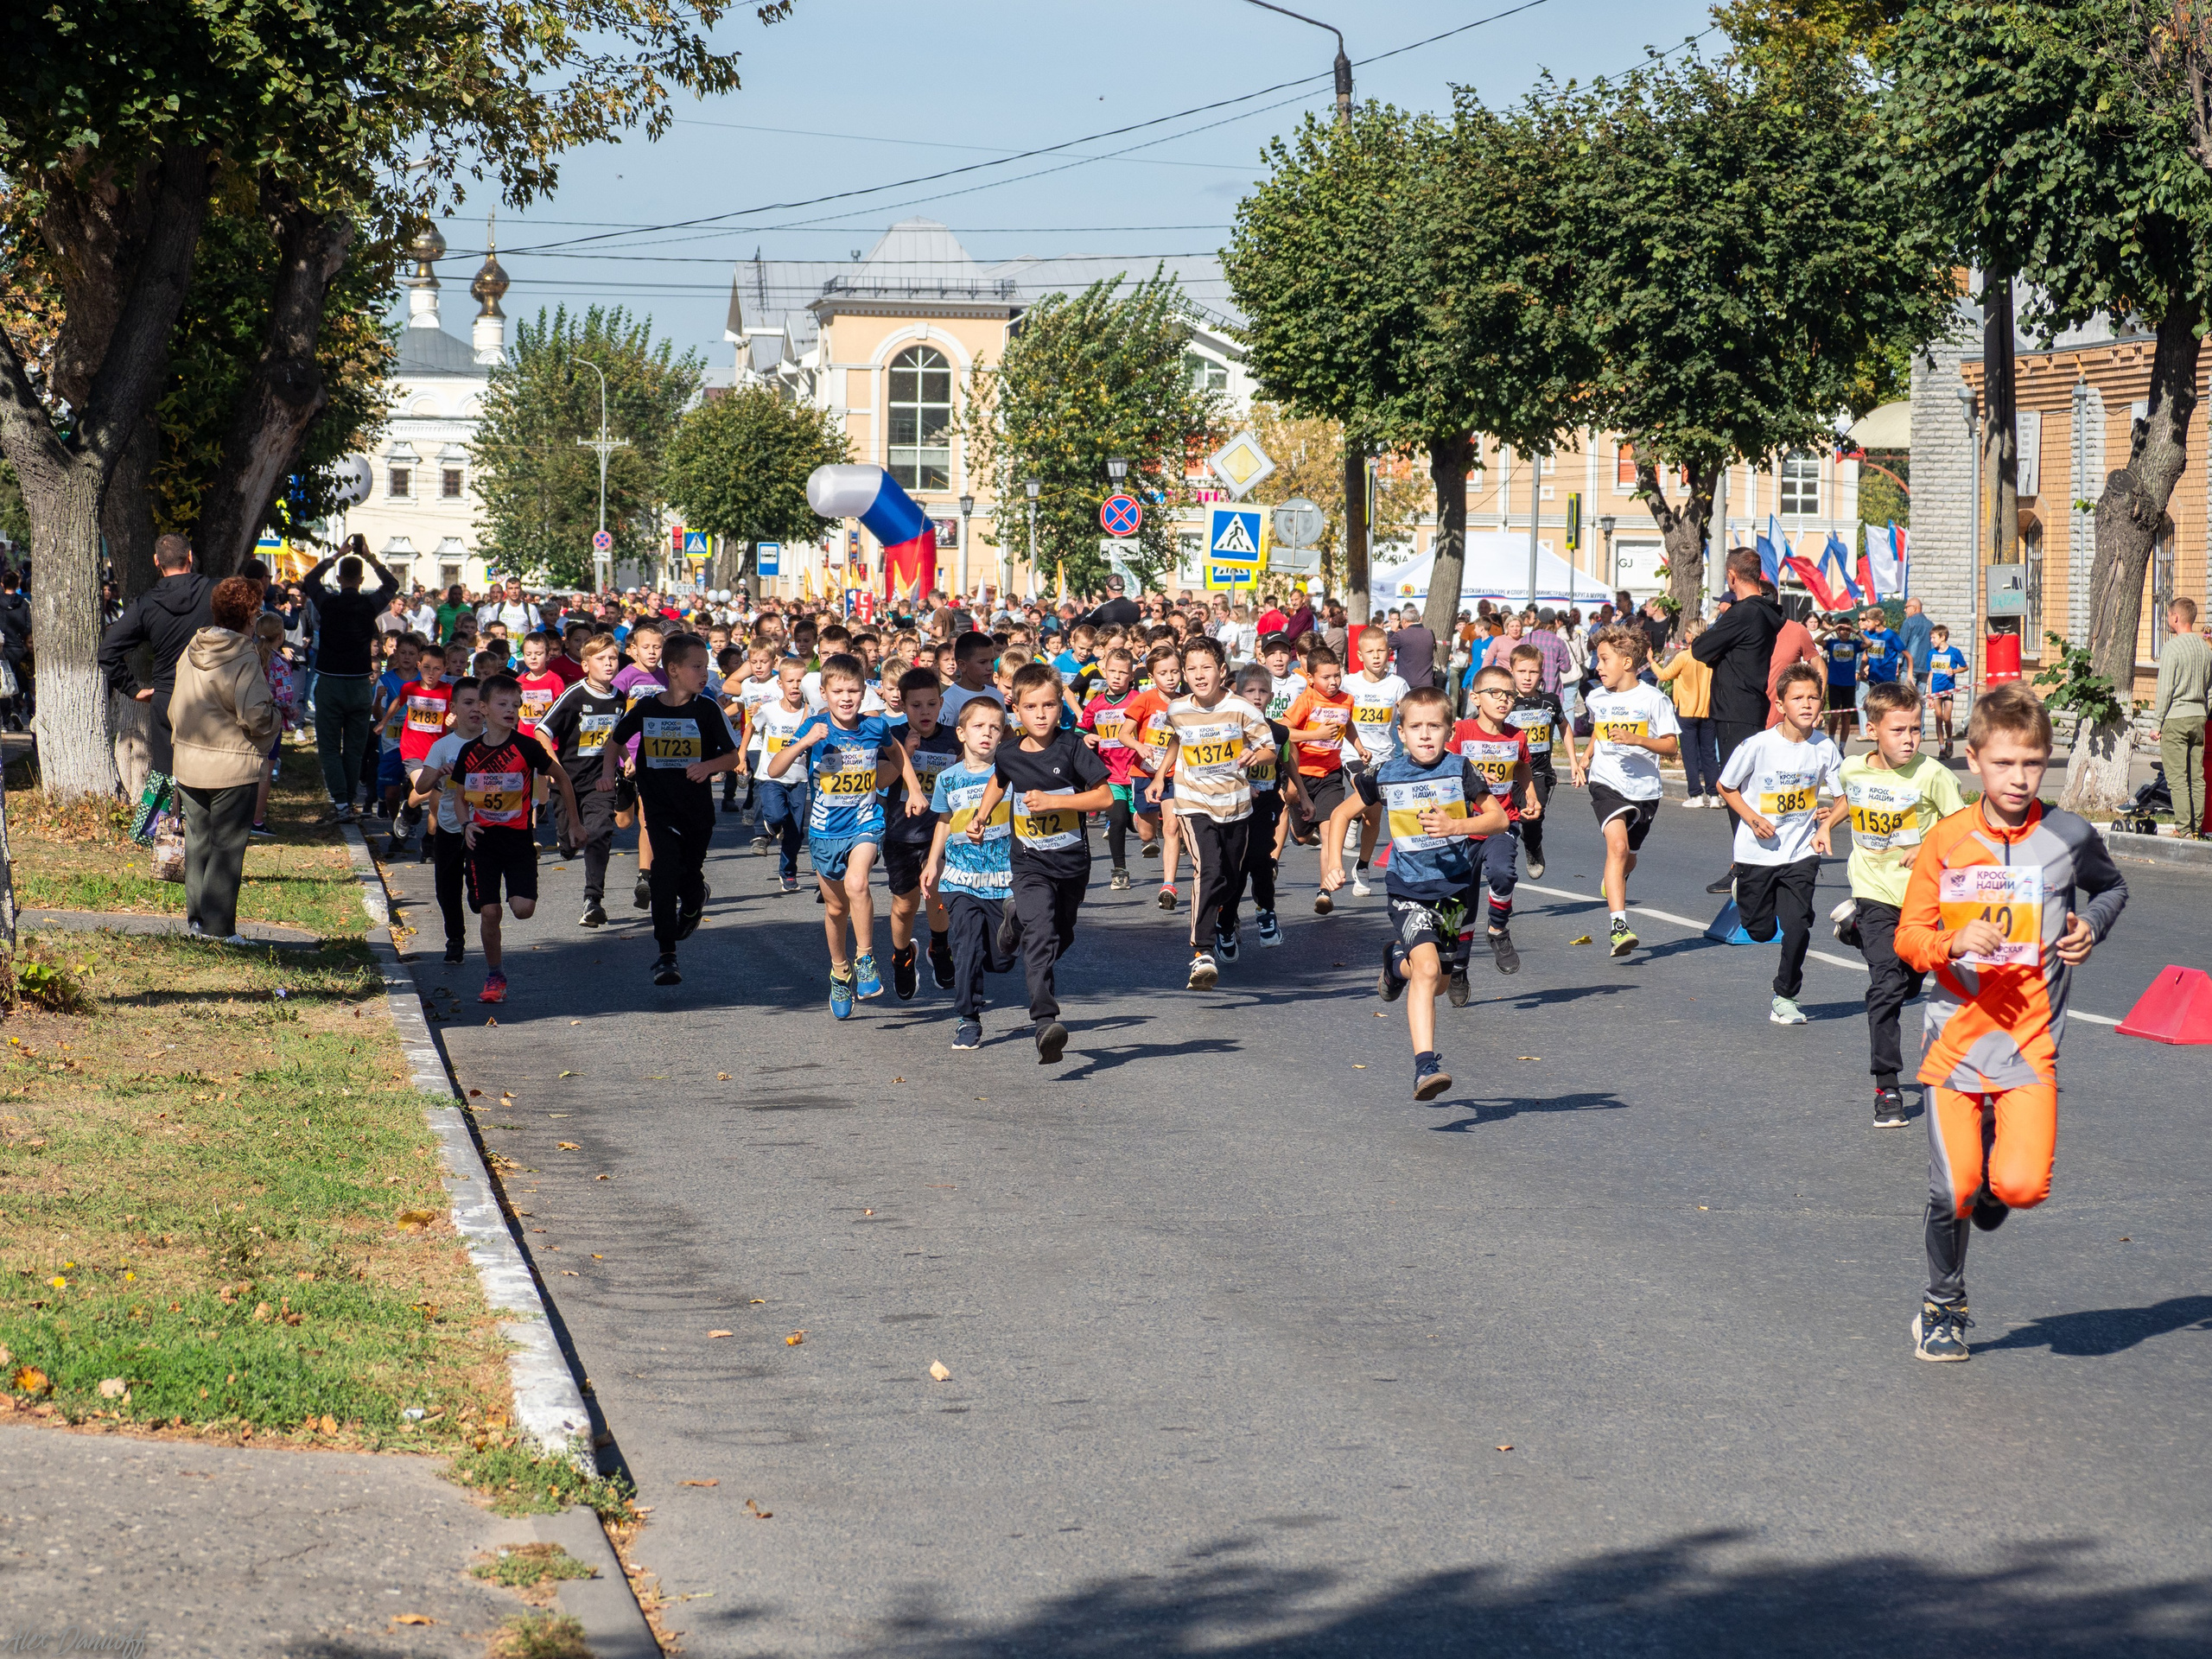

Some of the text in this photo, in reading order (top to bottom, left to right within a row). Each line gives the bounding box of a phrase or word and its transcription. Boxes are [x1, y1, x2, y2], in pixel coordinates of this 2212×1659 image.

[1618, 558, 1633, 568] GJ
[676, 585, 700, 594] СТОП
[412, 709, 439, 724] 2183
[1359, 709, 1384, 722] 234
[1522, 727, 1546, 742] 735
[652, 739, 693, 757] 1723
[1192, 741, 1234, 764] 1374
[1198, 762, 1233, 772] ВЛАДИМИРСКАЯ
[830, 772, 872, 793] 2520
[966, 786, 984, 795] КРОСС
[1411, 784, 1430, 793] КРОСС
[1869, 786, 1890, 796] КРОСС
[1412, 790, 1438, 800] НАЦИИ
[1868, 792, 1895, 803] НАЦИИ
[484, 793, 504, 810] 55
[1777, 791, 1806, 814] 885
[1026, 814, 1063, 836] 572
[1421, 839, 1446, 849] ОБЛАСТЬ
[1977, 871, 2006, 880] КРОСС
[1976, 880, 2015, 891] НАЦИИ
